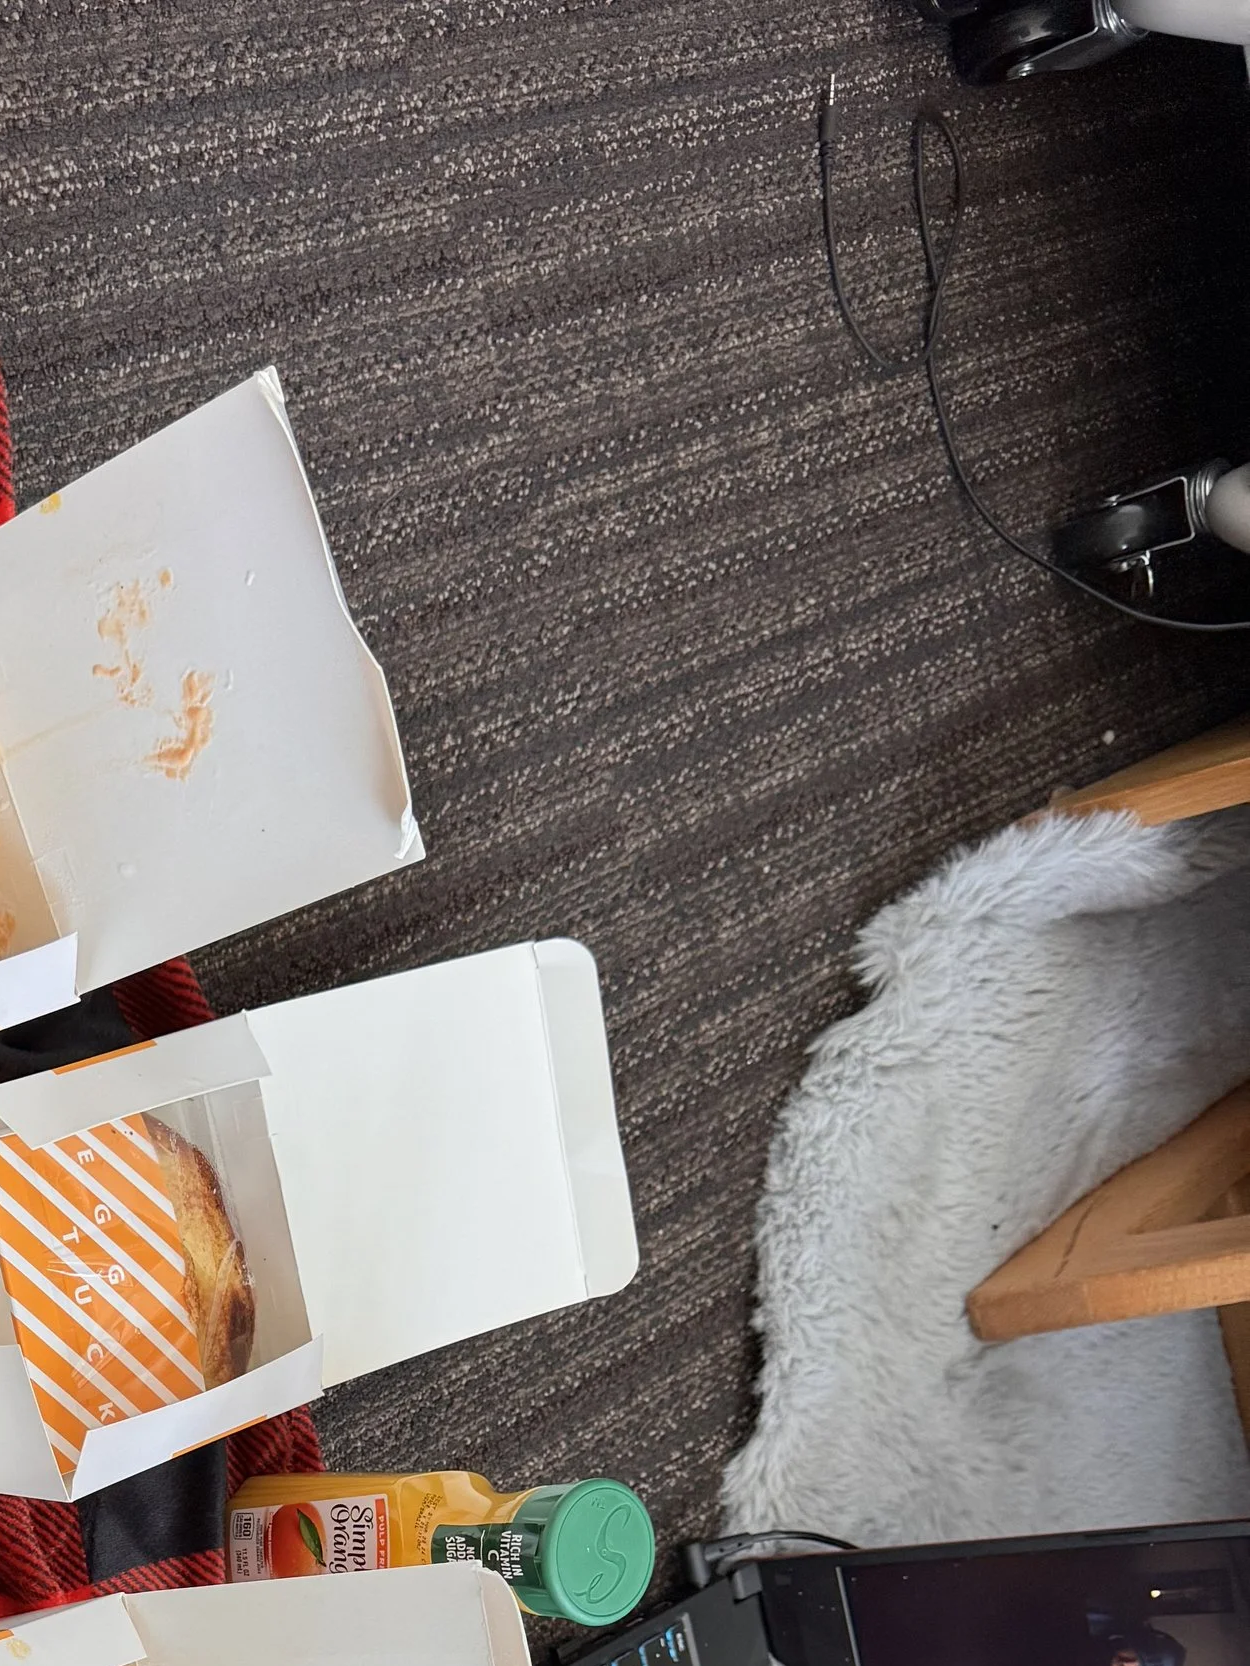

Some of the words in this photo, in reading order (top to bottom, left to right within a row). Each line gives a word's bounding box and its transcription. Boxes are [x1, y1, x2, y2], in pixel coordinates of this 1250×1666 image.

[77, 1148, 125, 1286] EGG
[62, 1225, 116, 1423] TUCK
[242, 1516, 252, 1537] 160
[329, 1504, 351, 1574] Orang
[445, 1536, 456, 1563] SUGA
[455, 1536, 466, 1562] ADD
[488, 1550, 499, 1561] C
[500, 1531, 513, 1579] VITAMIN
[510, 1534, 523, 1561] RICH
[511, 1564, 524, 1576] IN
